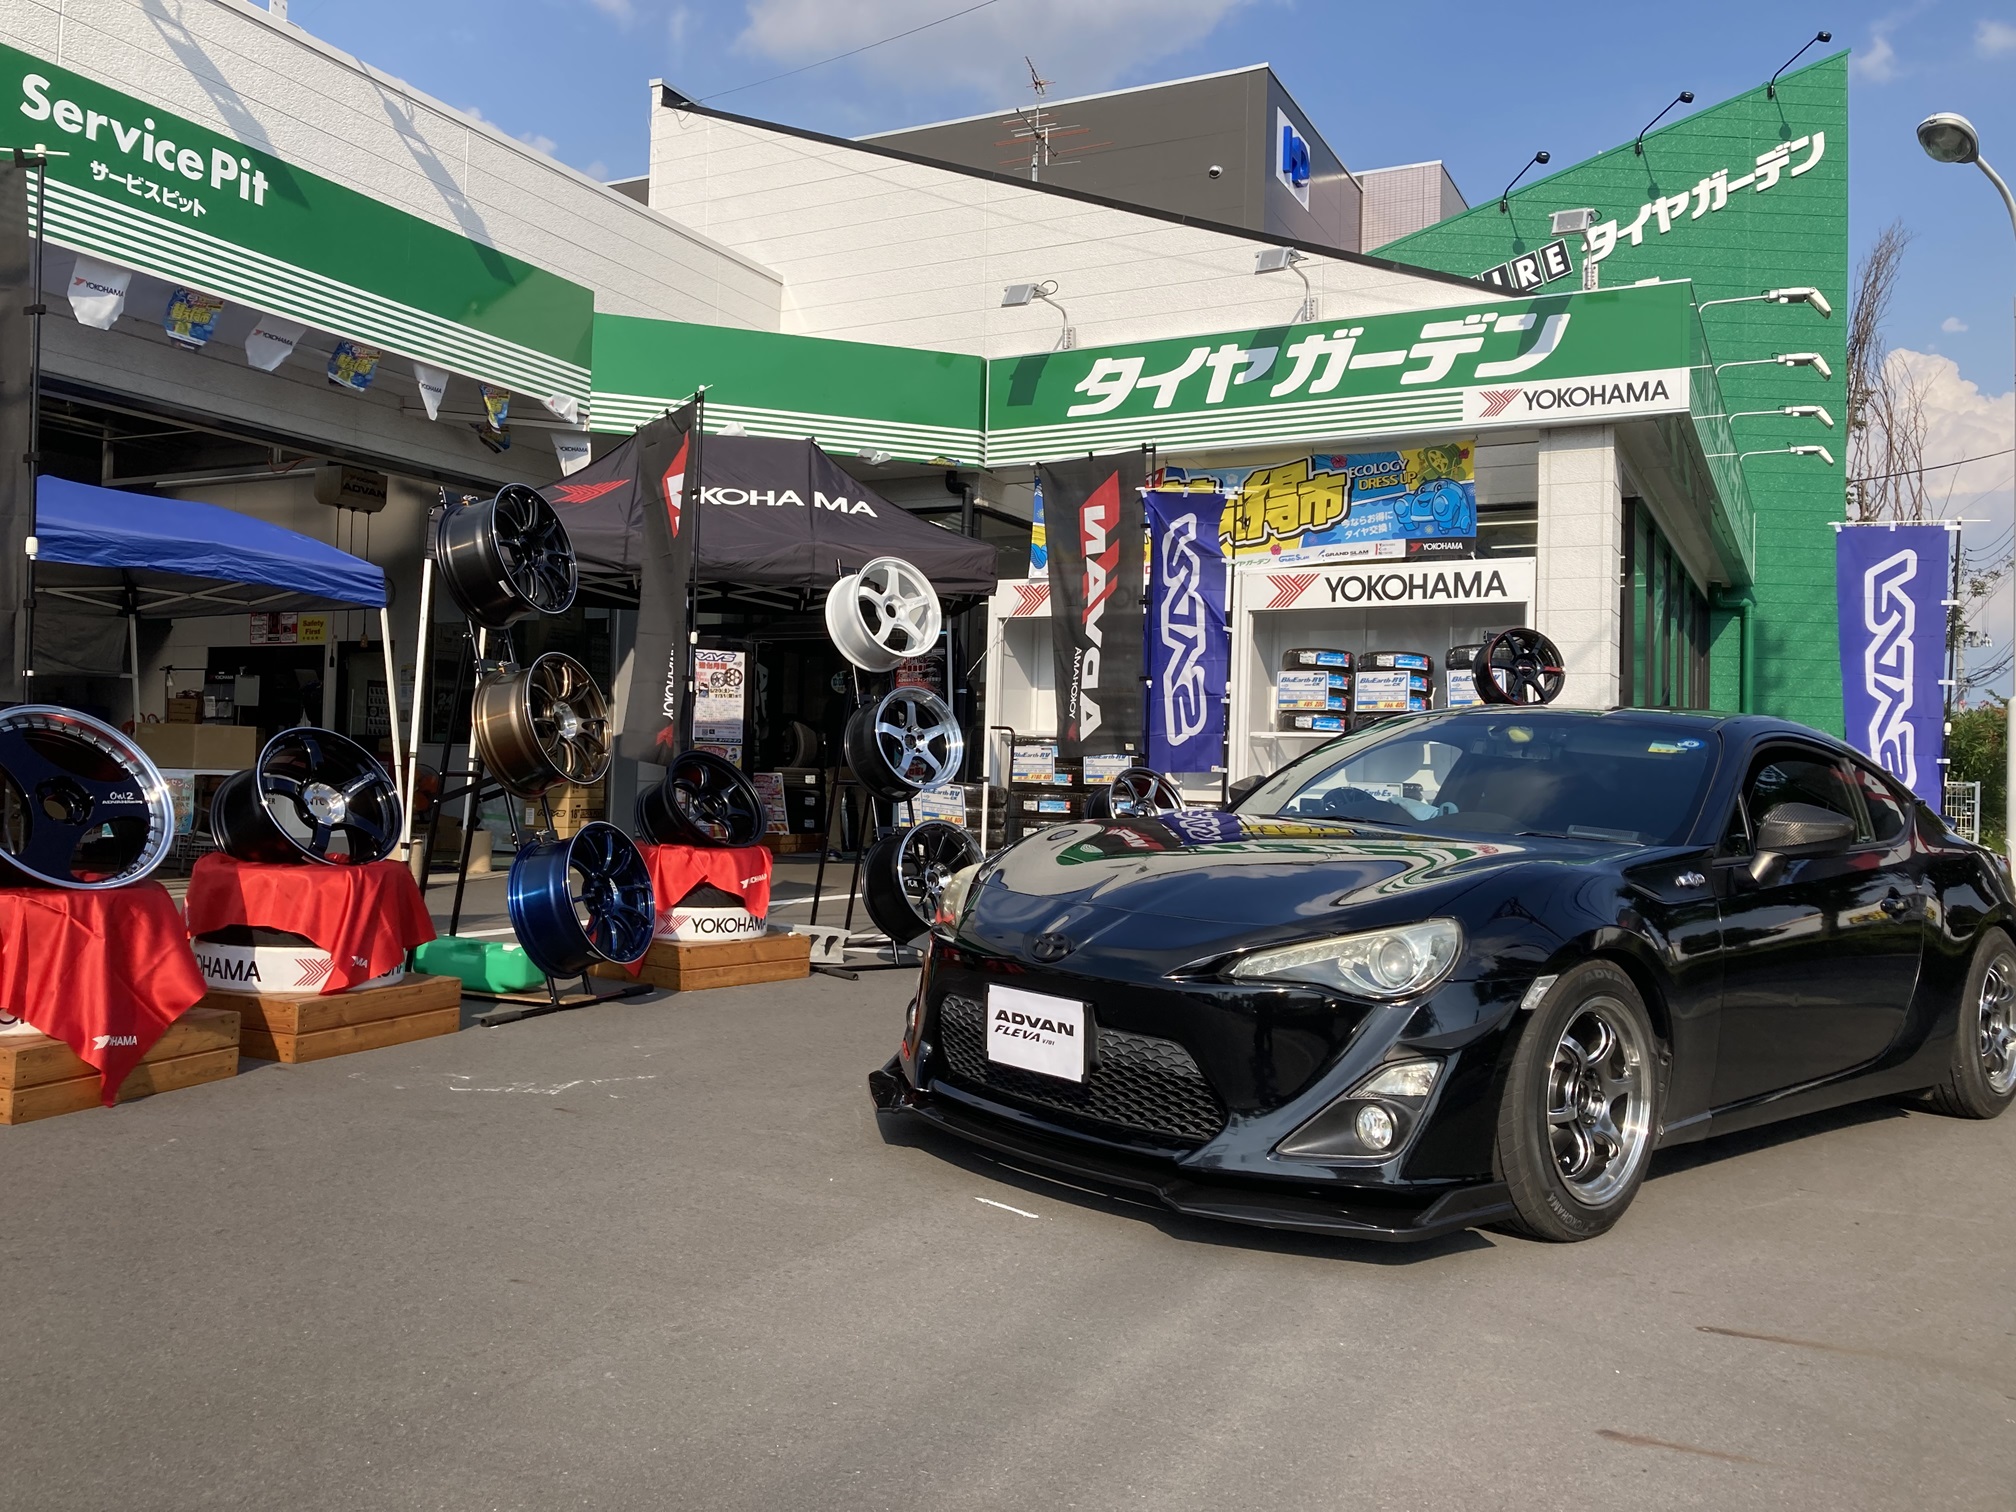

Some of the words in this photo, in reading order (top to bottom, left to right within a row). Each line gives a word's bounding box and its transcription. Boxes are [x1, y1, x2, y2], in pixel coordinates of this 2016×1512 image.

[20, 73, 204, 181] Service
[210, 147, 268, 206] Pit
[90, 160, 206, 217] サービスピット
[1581, 131, 1825, 263] タイヤガーデン
[85, 281, 124, 298] YOKOHAMA
[262, 331, 293, 346] YOKOHAMA
[1066, 312, 1571, 417] タイヤガーデン
[1523, 380, 1669, 411] YOKOHAMA
[1348, 459, 1409, 479] ECOLOGY
[343, 482, 386, 499] ADVAN
[1358, 474, 1399, 491] DRESS
[1399, 471, 1417, 485] UP
[1341, 510, 1393, 529] 今ならお得に
[1422, 542, 1463, 551] YOKOHAMA
[1325, 570, 1508, 602] YOKOHAMA
[302, 620, 325, 629] Safety
[304, 627, 321, 635] First
[695, 652, 737, 662] RAYS
[995, 1009, 1074, 1037] ADVAN
[994, 1024, 1041, 1043] FLEVA
